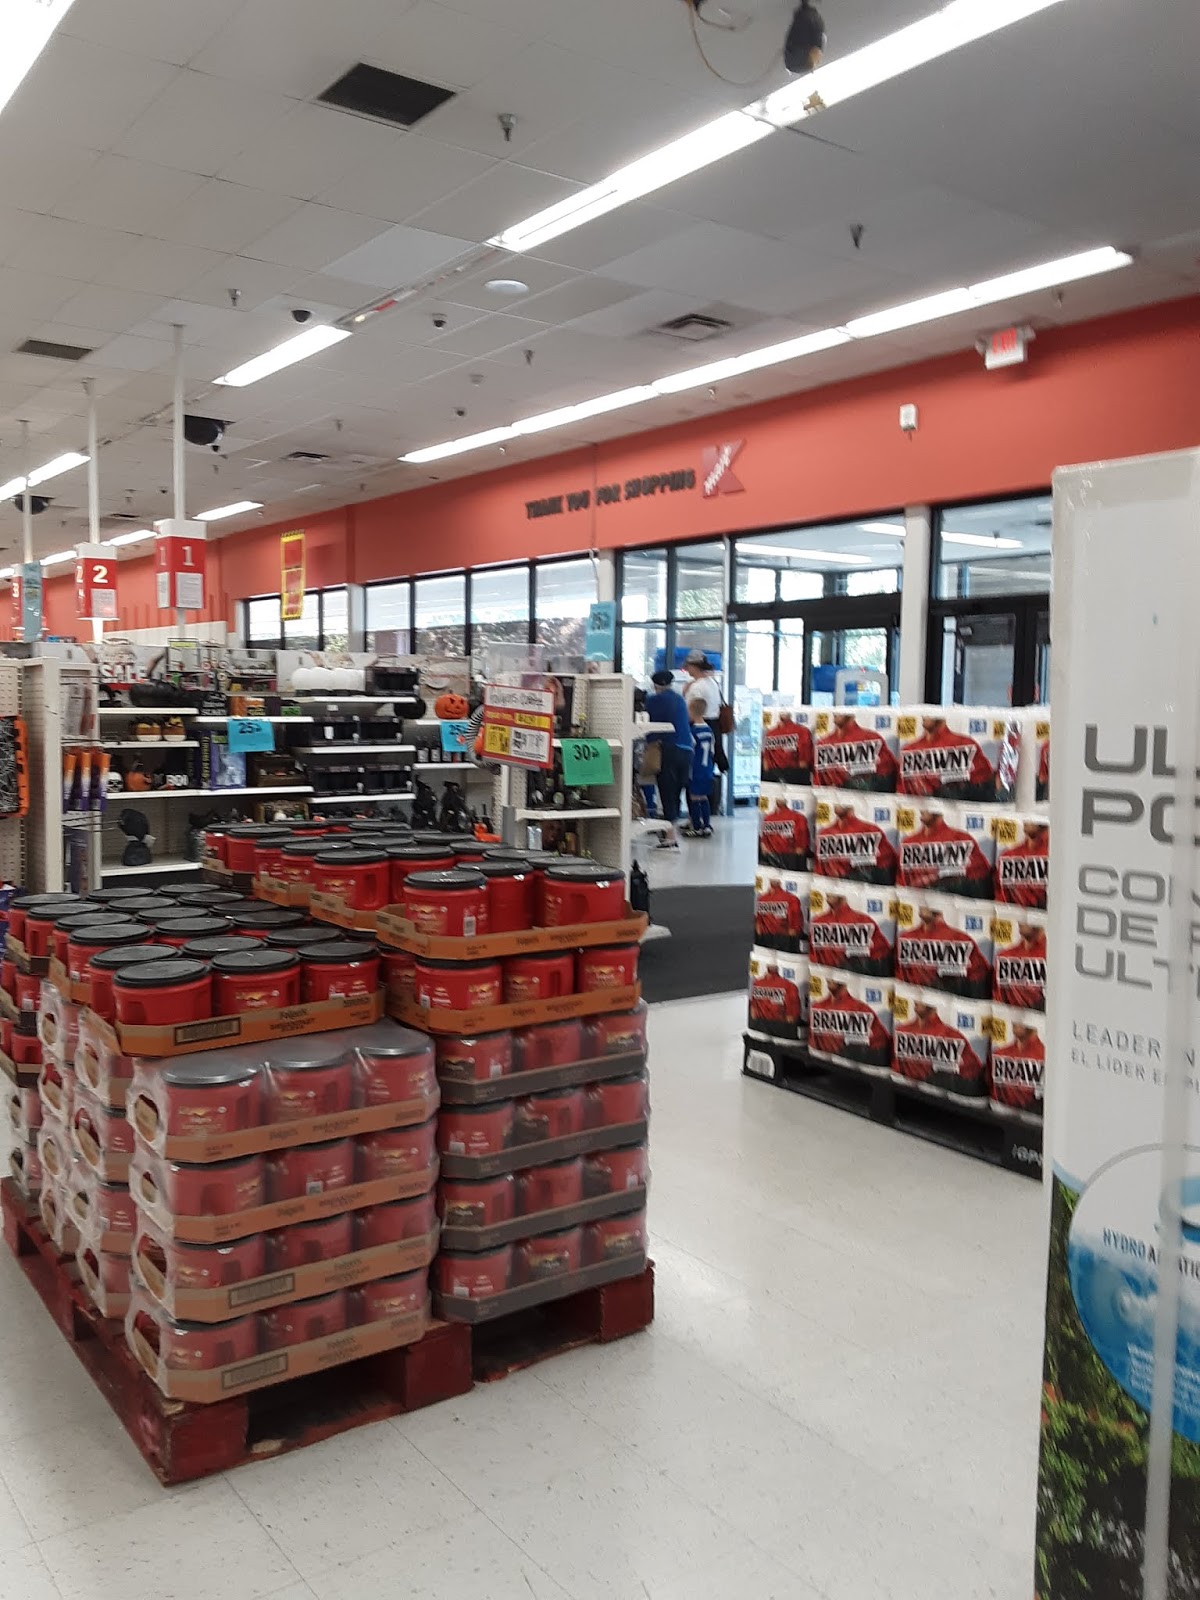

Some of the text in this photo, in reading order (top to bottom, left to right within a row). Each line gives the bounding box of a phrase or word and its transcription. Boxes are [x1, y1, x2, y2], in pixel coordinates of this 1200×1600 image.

[182, 545, 195, 566] 1
[92, 564, 109, 584] 2
[701, 742, 709, 767] 1
[816, 739, 881, 767] BRAWNY
[901, 746, 975, 774] BRAWNY
[817, 832, 881, 858] BRAWNY
[902, 840, 972, 870] BRAWNY
[1001, 856, 1048, 884] BRAW
[812, 923, 874, 947] BRAWNY
[900, 939, 973, 967] BRAWNY
[999, 958, 1046, 985] BRAW
[811, 1011, 873, 1035] BRAWNY
[897, 1034, 965, 1062] BRAWNY
[1072, 1020, 1162, 1061] LEADER
[993, 1055, 1044, 1086] BRAW
